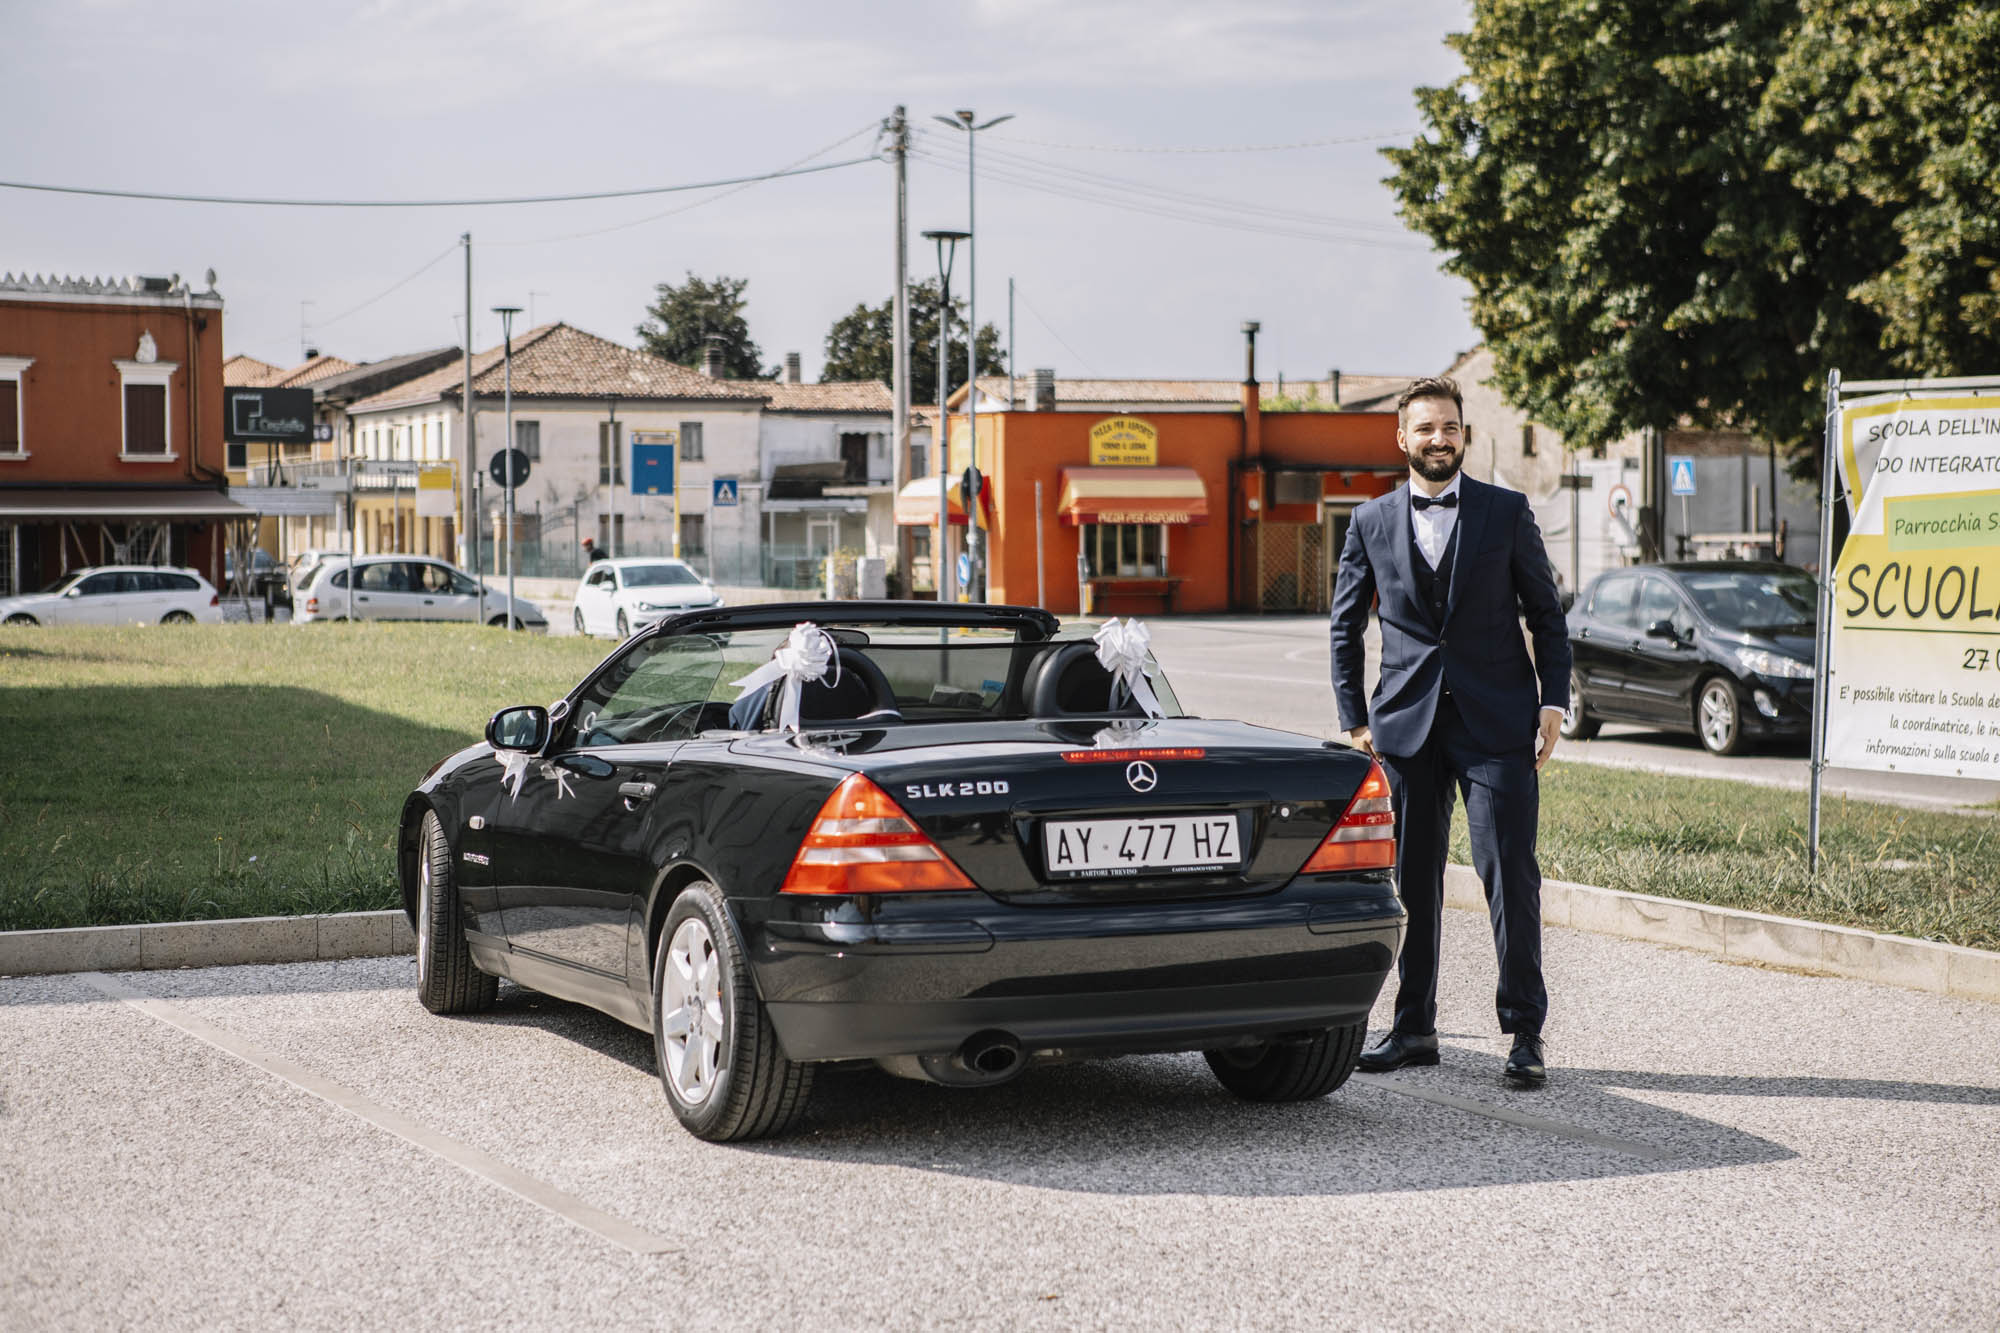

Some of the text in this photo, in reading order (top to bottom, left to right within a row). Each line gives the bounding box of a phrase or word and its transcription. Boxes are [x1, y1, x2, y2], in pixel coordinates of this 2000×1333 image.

[1894, 512, 1981, 536] Parrocchia
[1846, 561, 2000, 620] SCUOL
[1962, 648, 1990, 672] 27
[1853, 686, 1895, 705] possibile
[1898, 688, 1935, 704] visitare
[1938, 690, 1947, 704] la
[1951, 692, 1984, 708] Scuola
[1890, 714, 1899, 729] la
[1902, 717, 1974, 736] coordinatrice,
[1976, 721, 1985, 735] le
[1865, 739, 1931, 758] informazioni
[1933, 744, 1956, 760] sulla
[1959, 748, 1990, 763] scuola
[906, 780, 1009, 799] SLK 200
[1057, 822, 1233, 864] AY 477 HZ
